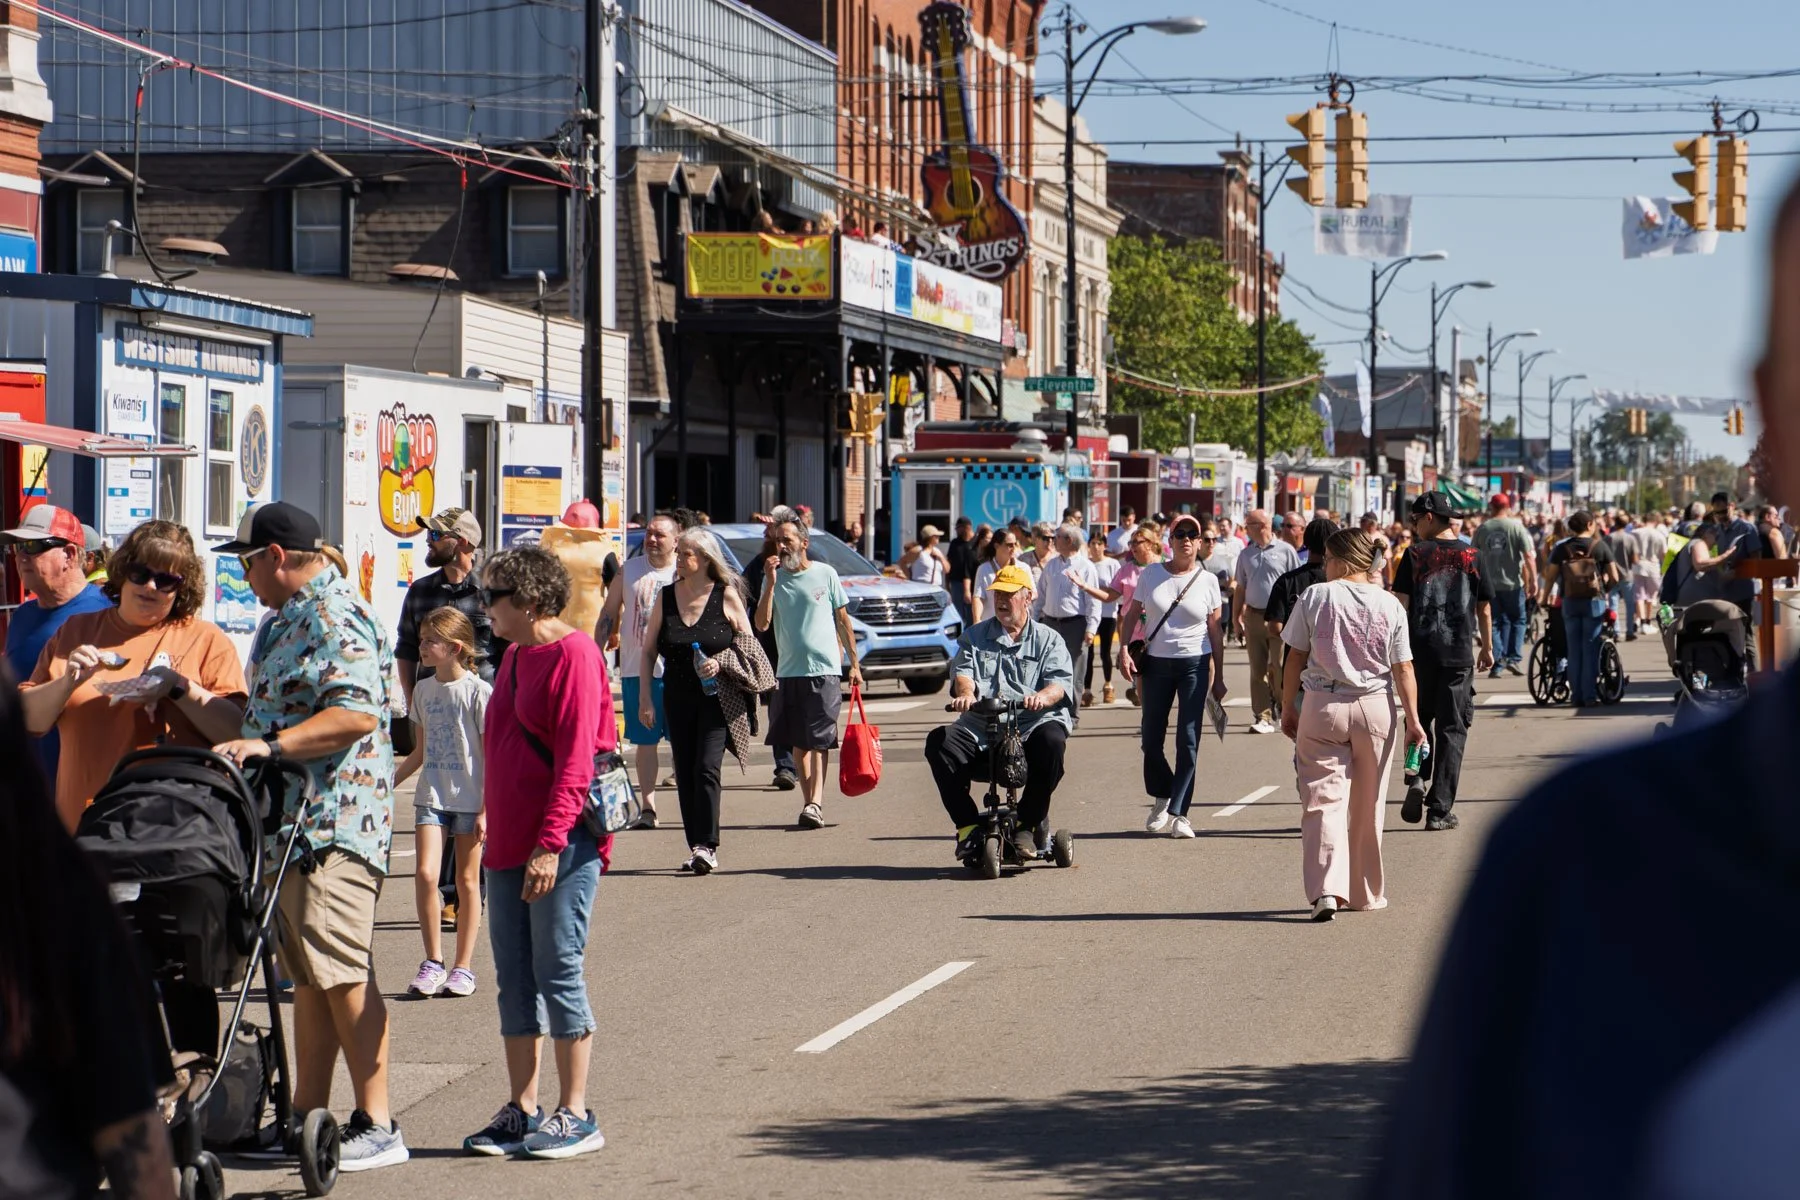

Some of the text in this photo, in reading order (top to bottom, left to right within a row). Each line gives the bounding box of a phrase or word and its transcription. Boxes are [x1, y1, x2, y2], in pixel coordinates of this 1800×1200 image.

[1341, 215, 1388, 228] RURAL
[0, 255, 26, 272] AW
[929, 237, 1019, 278] STRINGS
[123, 327, 260, 378] WESTSIDE KIWANIS
[1037, 379, 1086, 391] Eleventh
[112, 393, 142, 412] Kiwanis
[393, 490, 421, 526] BUN
